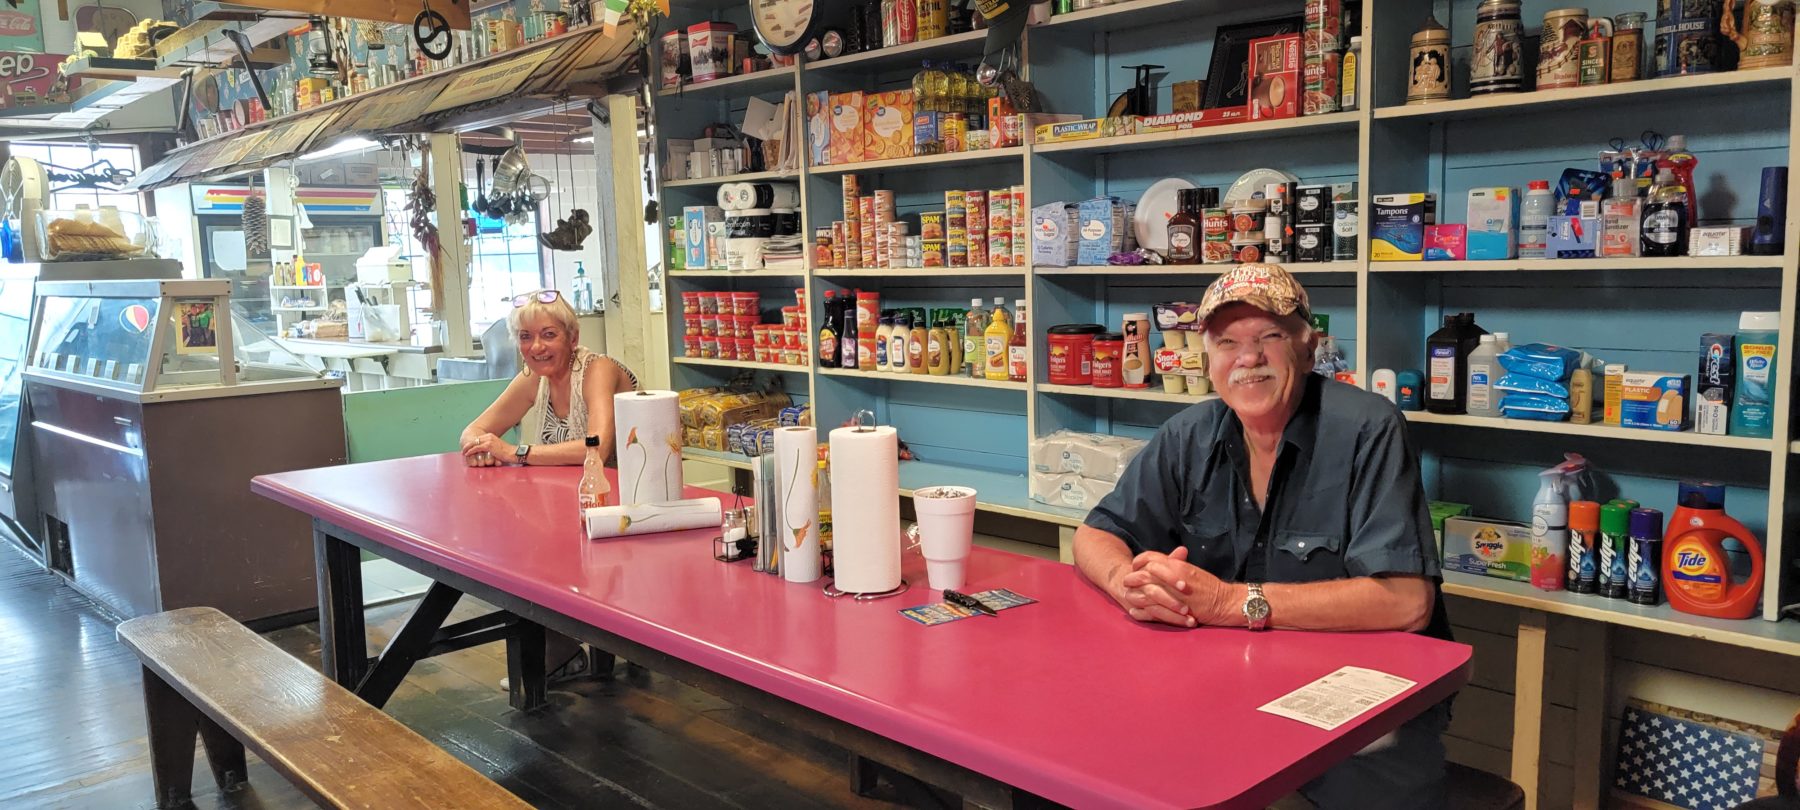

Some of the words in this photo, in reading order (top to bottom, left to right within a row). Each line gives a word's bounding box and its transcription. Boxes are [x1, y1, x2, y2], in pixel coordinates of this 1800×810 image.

[1679, 21, 1705, 32] HOUSE
[0, 54, 34, 77] ep
[1143, 112, 1204, 127] DIAMOND
[1054, 123, 1076, 134] PLASTIC
[1077, 122, 1096, 132] WRAP
[1376, 208, 1409, 217] Tampons
[921, 215, 940, 224] SPAM
[1203, 218, 1229, 228] Hunt's
[921, 243, 941, 252] SPAM
[1156, 353, 1180, 363] Snack
[1709, 343, 1724, 386] Crest
[1475, 541, 1504, 550] Snuggle
[1568, 528, 1586, 574] edge
[1599, 531, 1617, 578] edge
[1627, 535, 1643, 583] edge
[1677, 552, 1707, 568] Tide
